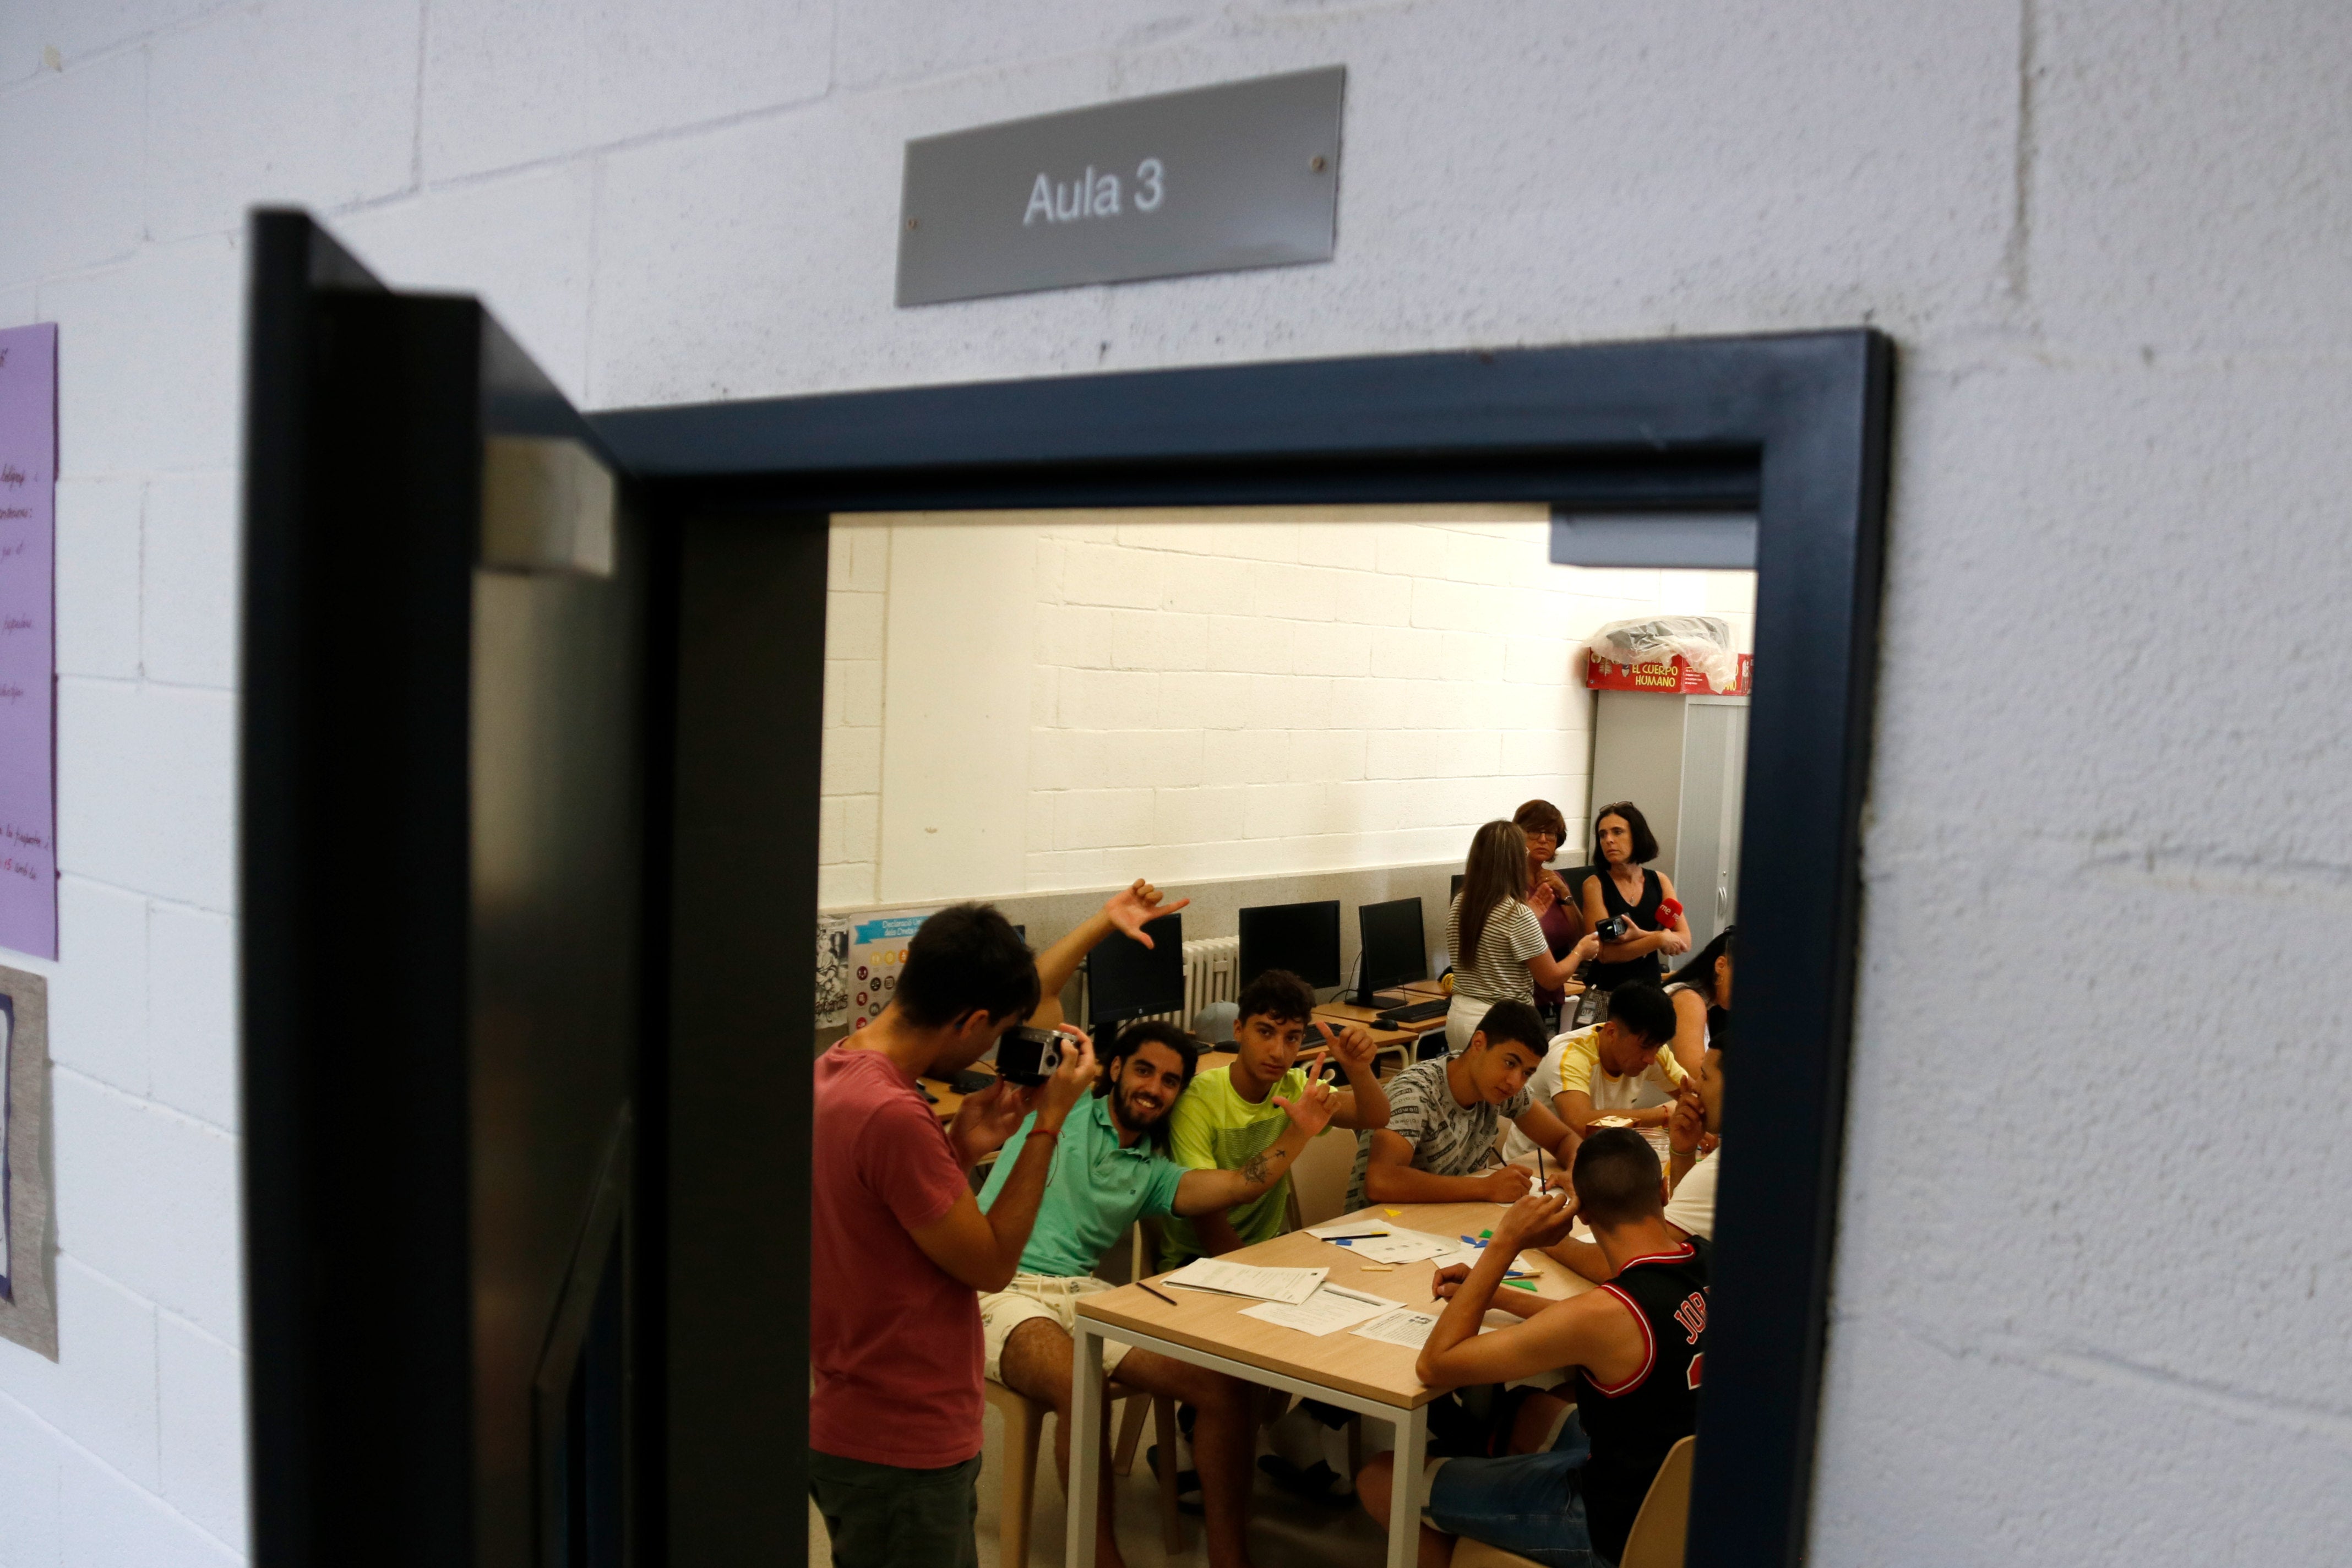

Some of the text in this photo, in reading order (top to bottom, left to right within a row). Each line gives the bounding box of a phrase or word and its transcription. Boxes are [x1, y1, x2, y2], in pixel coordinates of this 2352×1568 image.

[1023, 156, 1165, 226] Aula 3
[1632, 664, 1678, 676] EL CUERPO
[1635, 674, 1675, 687] HUMANO
